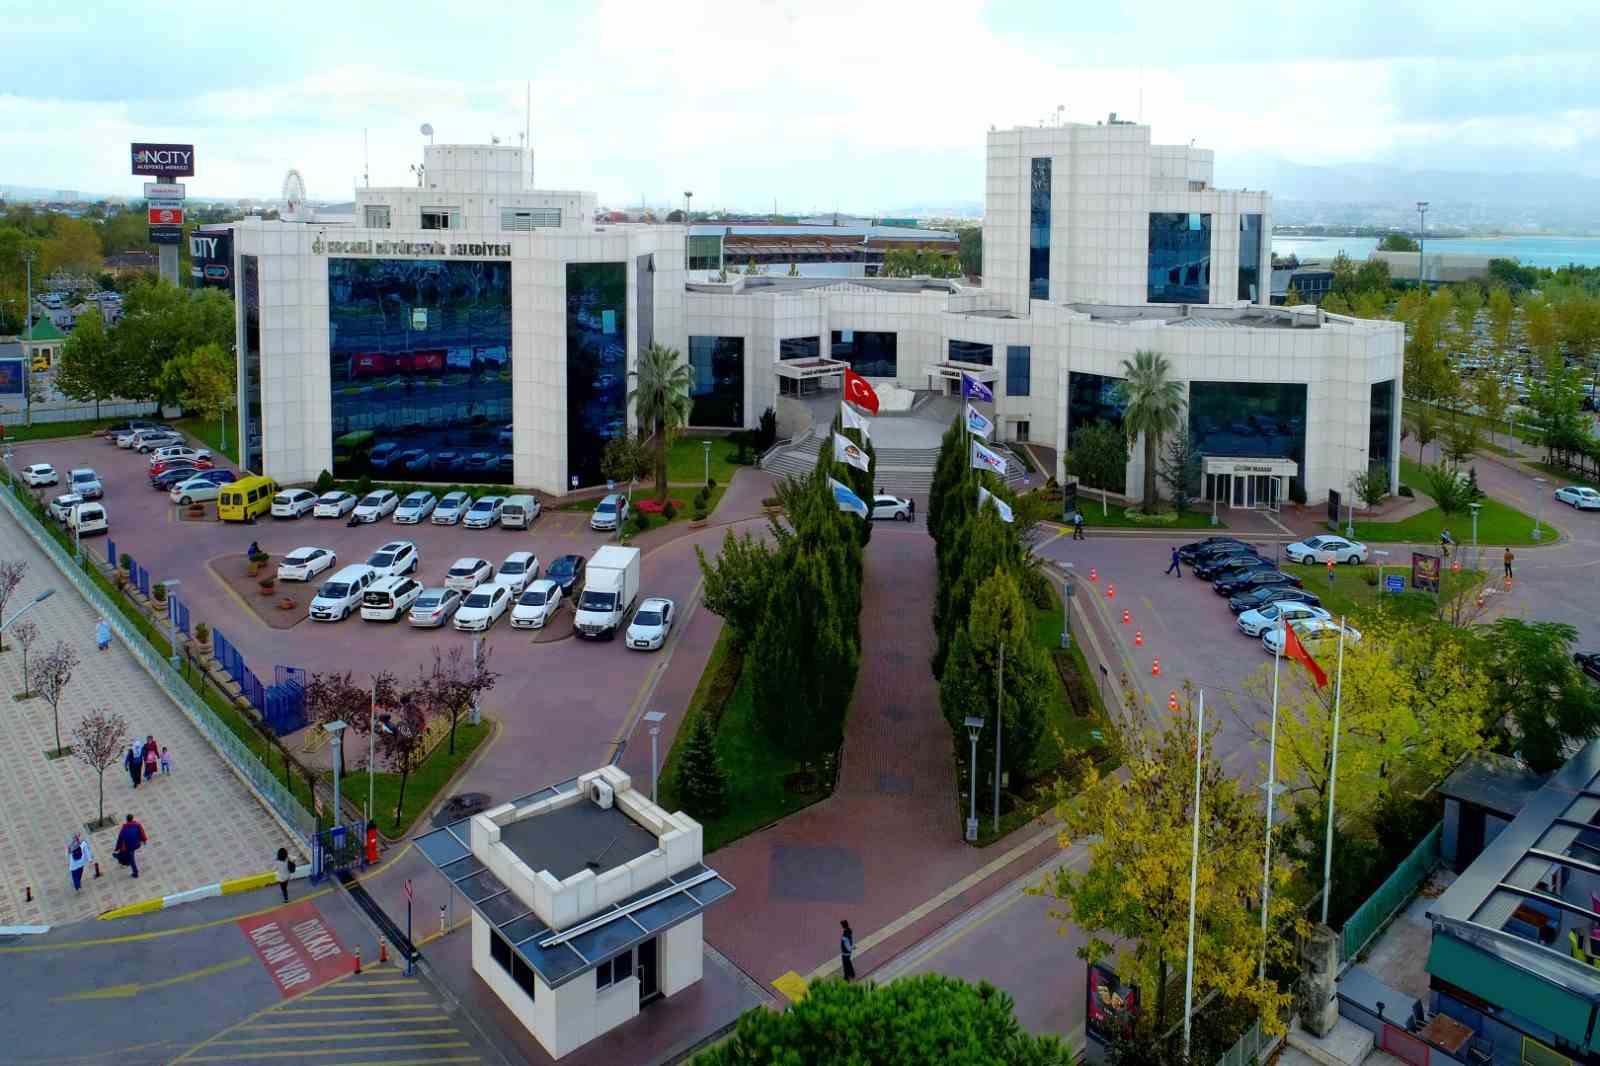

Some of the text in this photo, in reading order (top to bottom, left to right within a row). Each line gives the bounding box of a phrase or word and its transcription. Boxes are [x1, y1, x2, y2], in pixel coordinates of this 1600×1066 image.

[450, 241, 511, 257] BELEDİYESİ
[248, 922, 312, 990] KAPAN VAR
